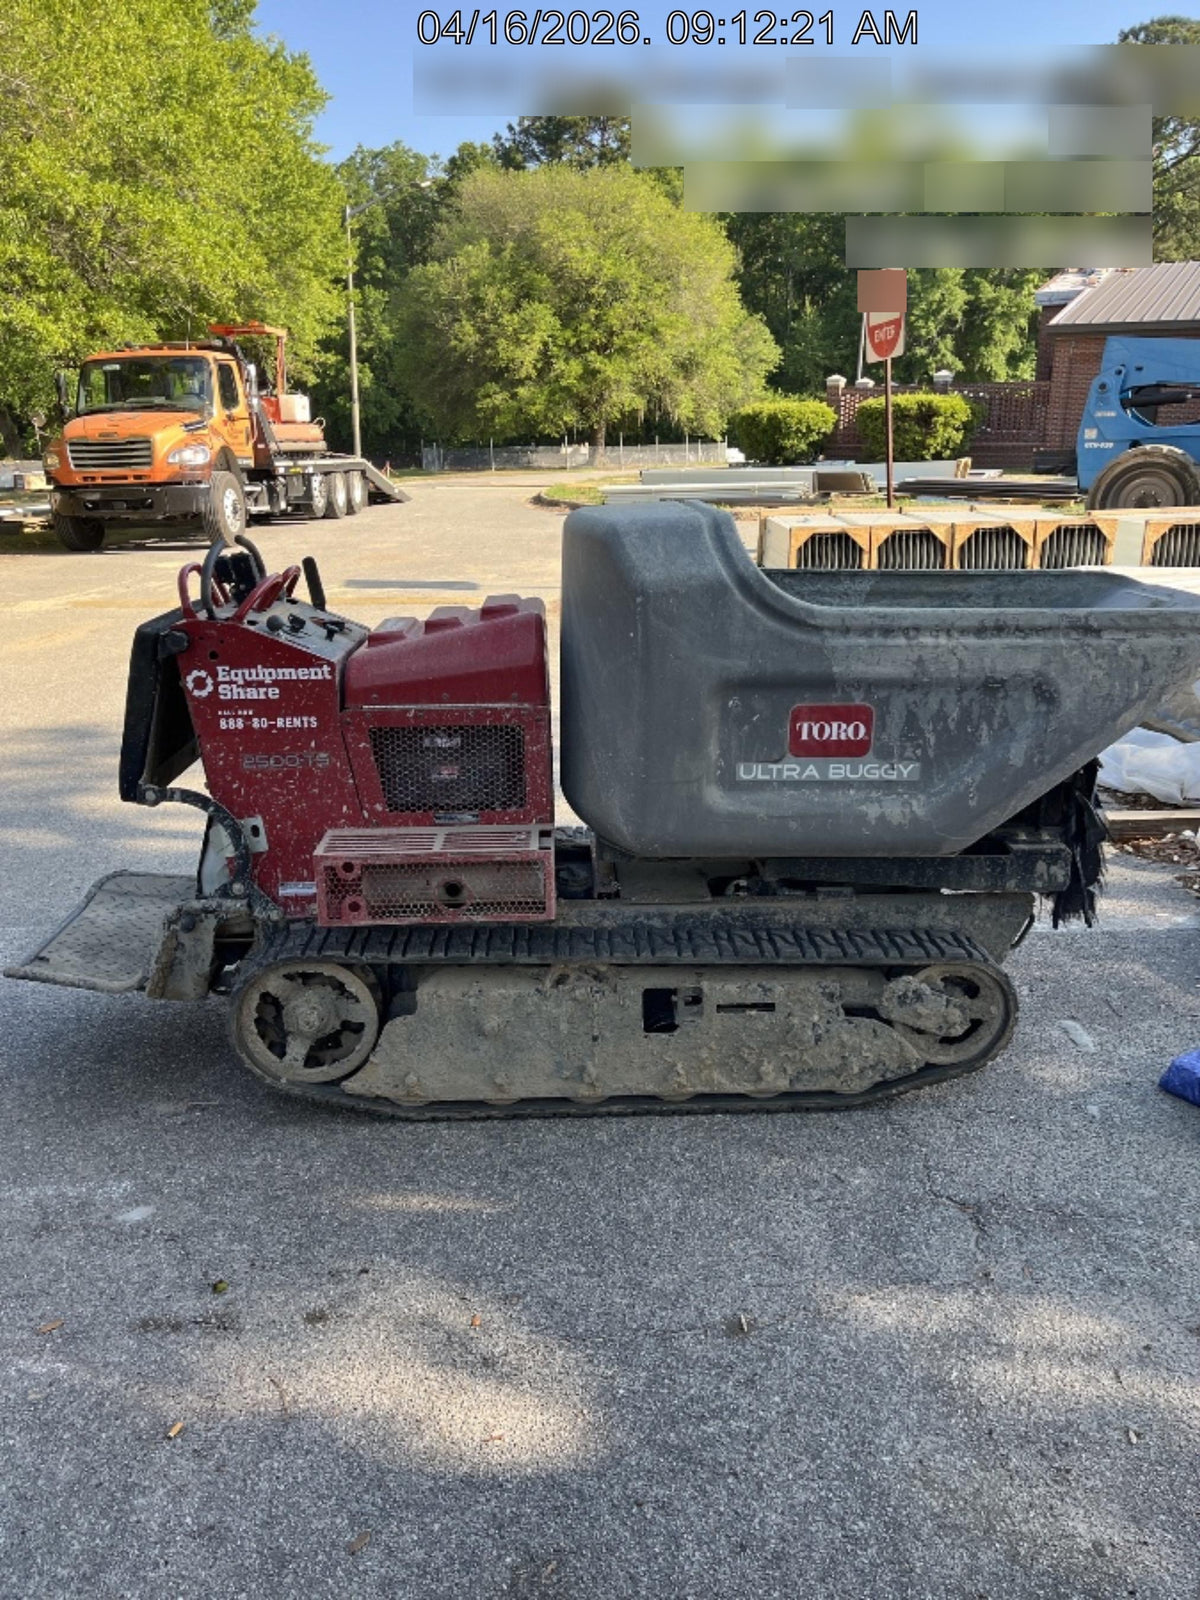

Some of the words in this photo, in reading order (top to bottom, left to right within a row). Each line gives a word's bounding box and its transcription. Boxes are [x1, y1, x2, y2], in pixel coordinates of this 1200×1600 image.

[216, 664, 332, 684] Equipment
[217, 684, 280, 700] Share
[796, 721, 867, 741] TORO
[739, 763, 820, 780] ULTRA
[828, 763, 915, 780] BUGGY
